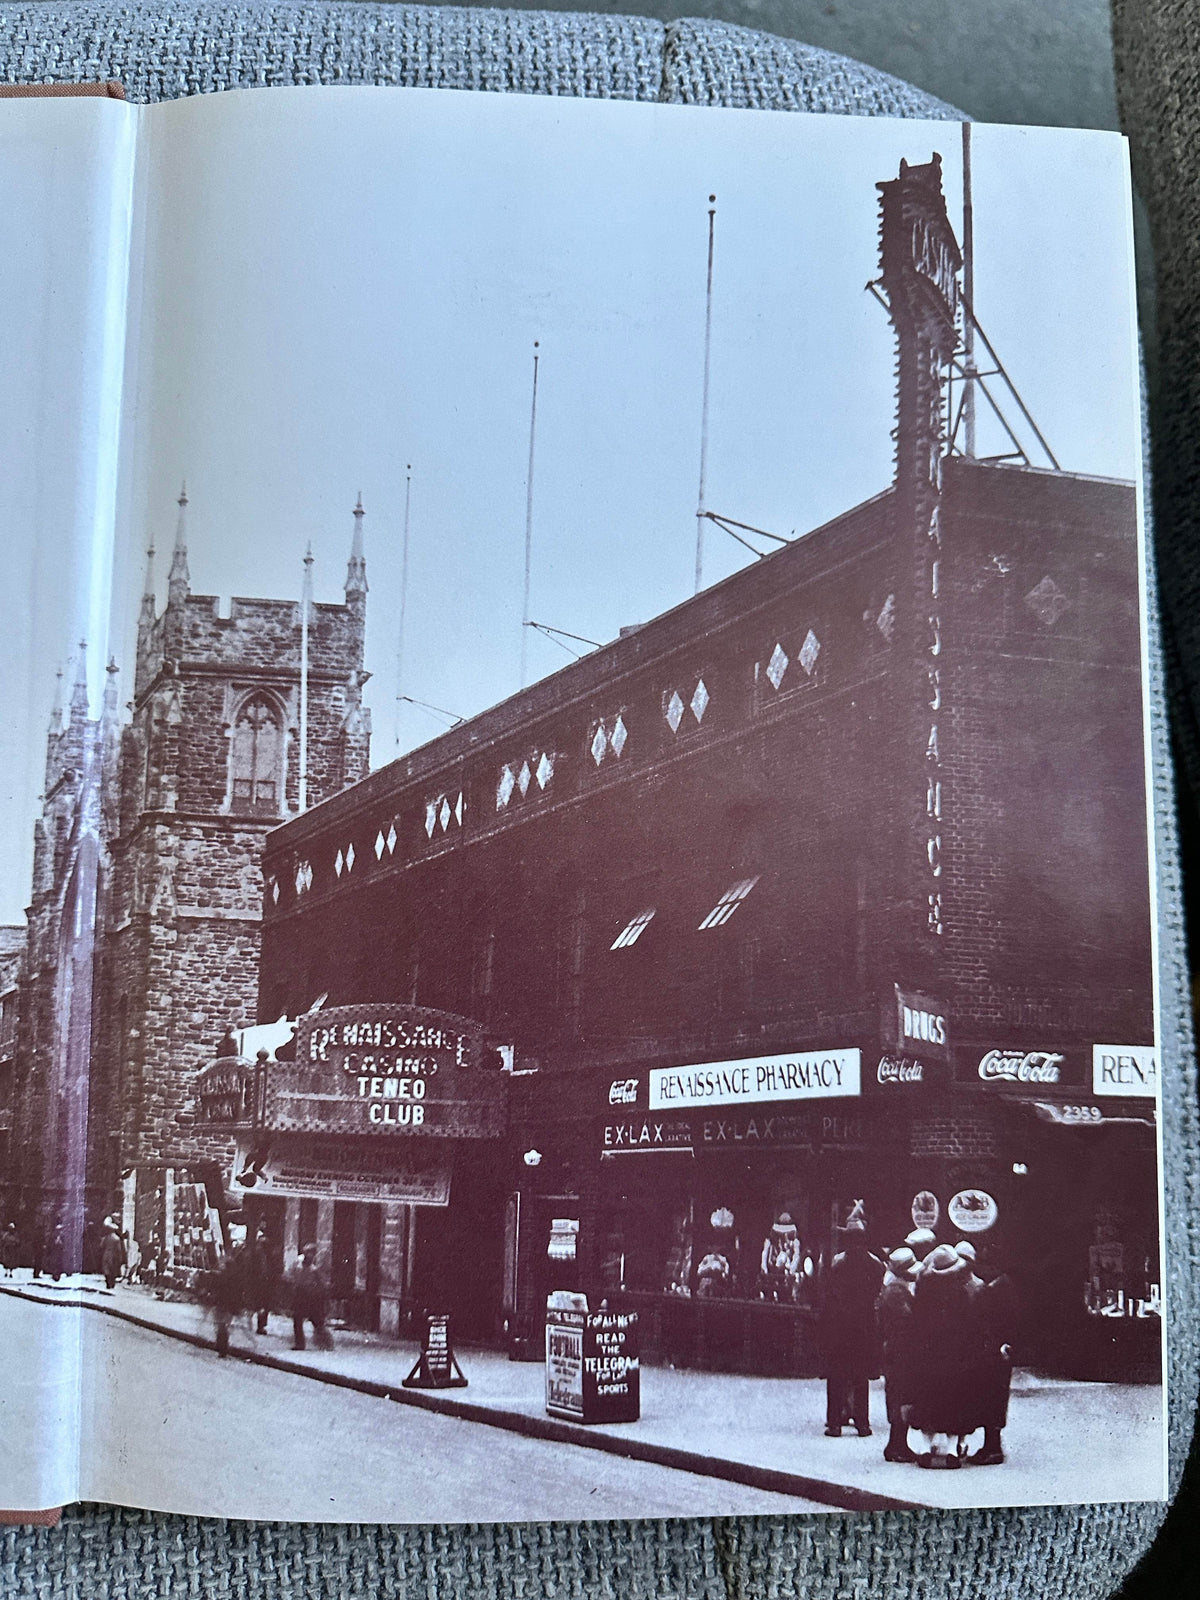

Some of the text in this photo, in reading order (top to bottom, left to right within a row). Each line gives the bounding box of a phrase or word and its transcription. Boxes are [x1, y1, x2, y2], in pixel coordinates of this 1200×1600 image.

[903, 1006, 946, 1045] DRUGS
[309, 1019, 471, 1068] RENAISSANCE
[343, 1053, 438, 1076] CASINO
[357, 1077, 427, 1099] TENEO
[660, 1058, 846, 1100] RENAISSANCE PHARMACY
[369, 1103, 425, 1126] CLUB
[1063, 1105, 1102, 1121] 2359
[602, 1314, 617, 1329] ALL
[596, 1332, 626, 1345] READ
[601, 1345, 620, 1355] THE
[585, 1356, 640, 1373] TELEGRAM
[597, 1382, 628, 1396] SPORTS
